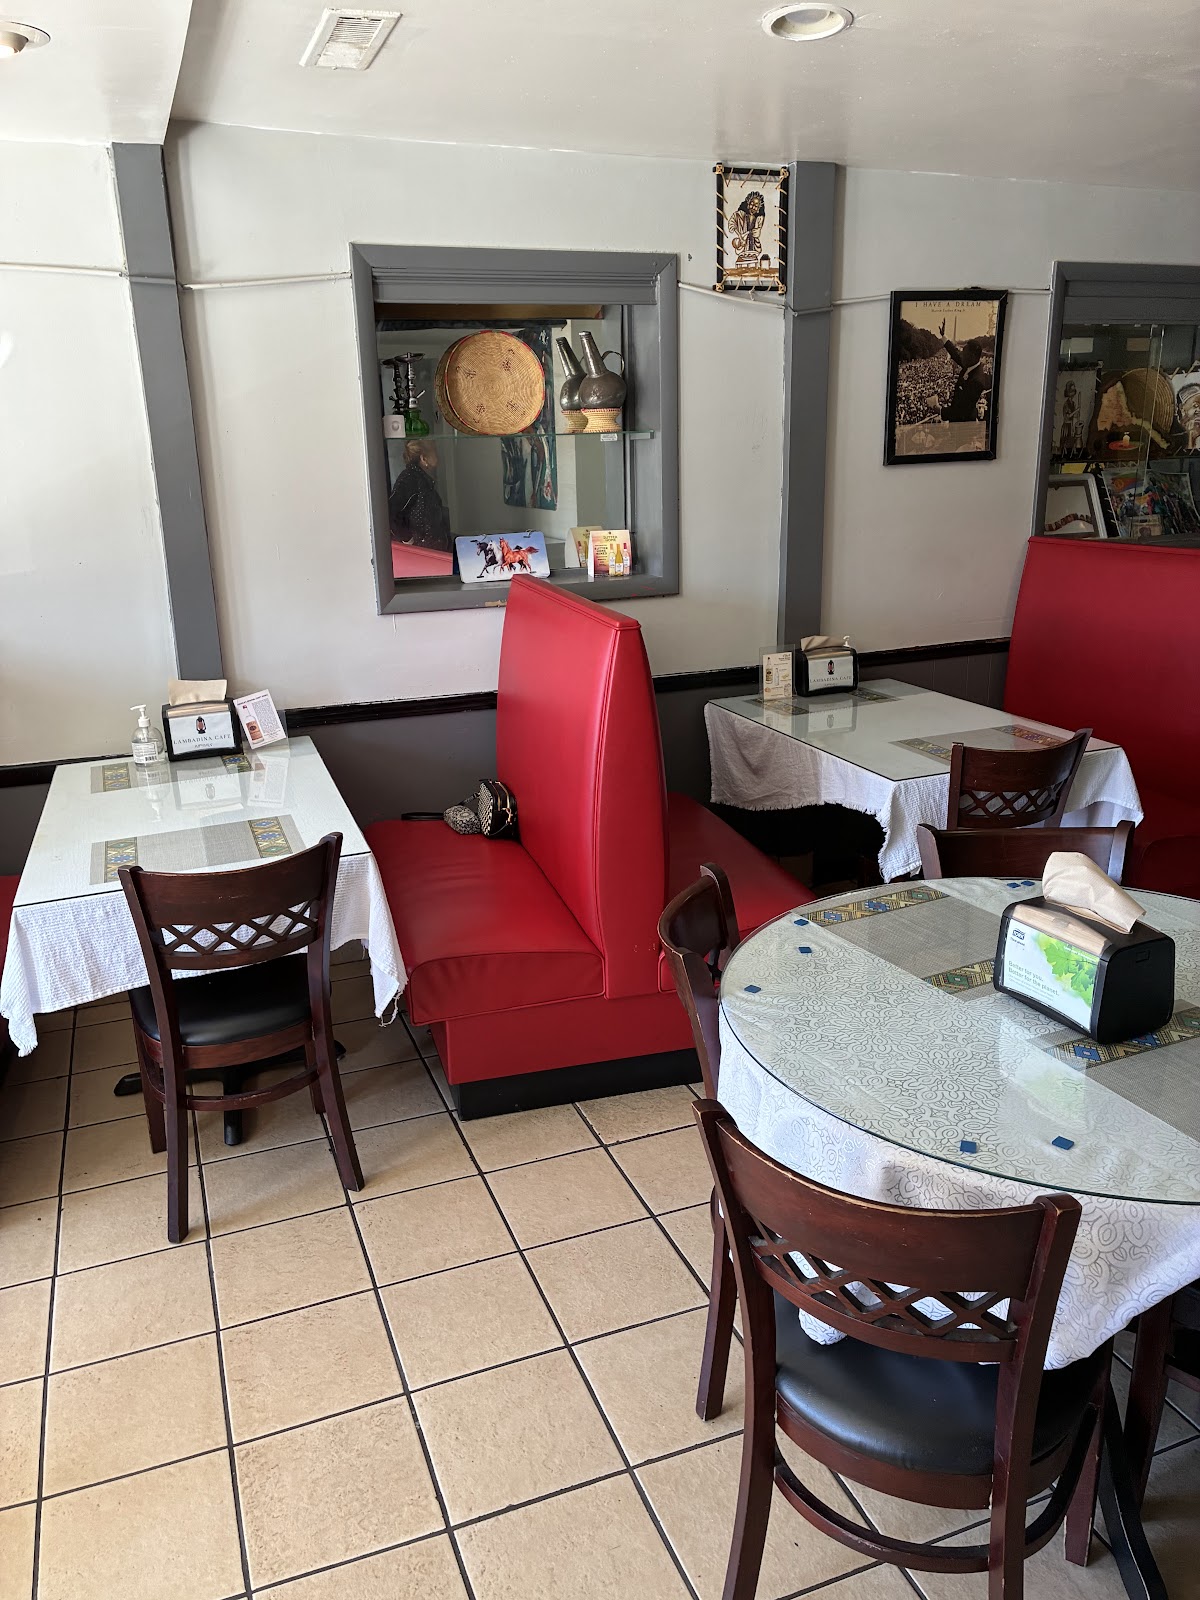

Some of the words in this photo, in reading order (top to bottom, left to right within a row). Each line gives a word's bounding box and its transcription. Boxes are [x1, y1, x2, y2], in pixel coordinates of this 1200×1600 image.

[174, 736, 213, 744] LAMBADINA
[1008, 960, 1024, 972] Better
[1024, 968, 1032, 976] for
[1008, 967, 1024, 978] Better
[1032, 979, 1041, 987] the
